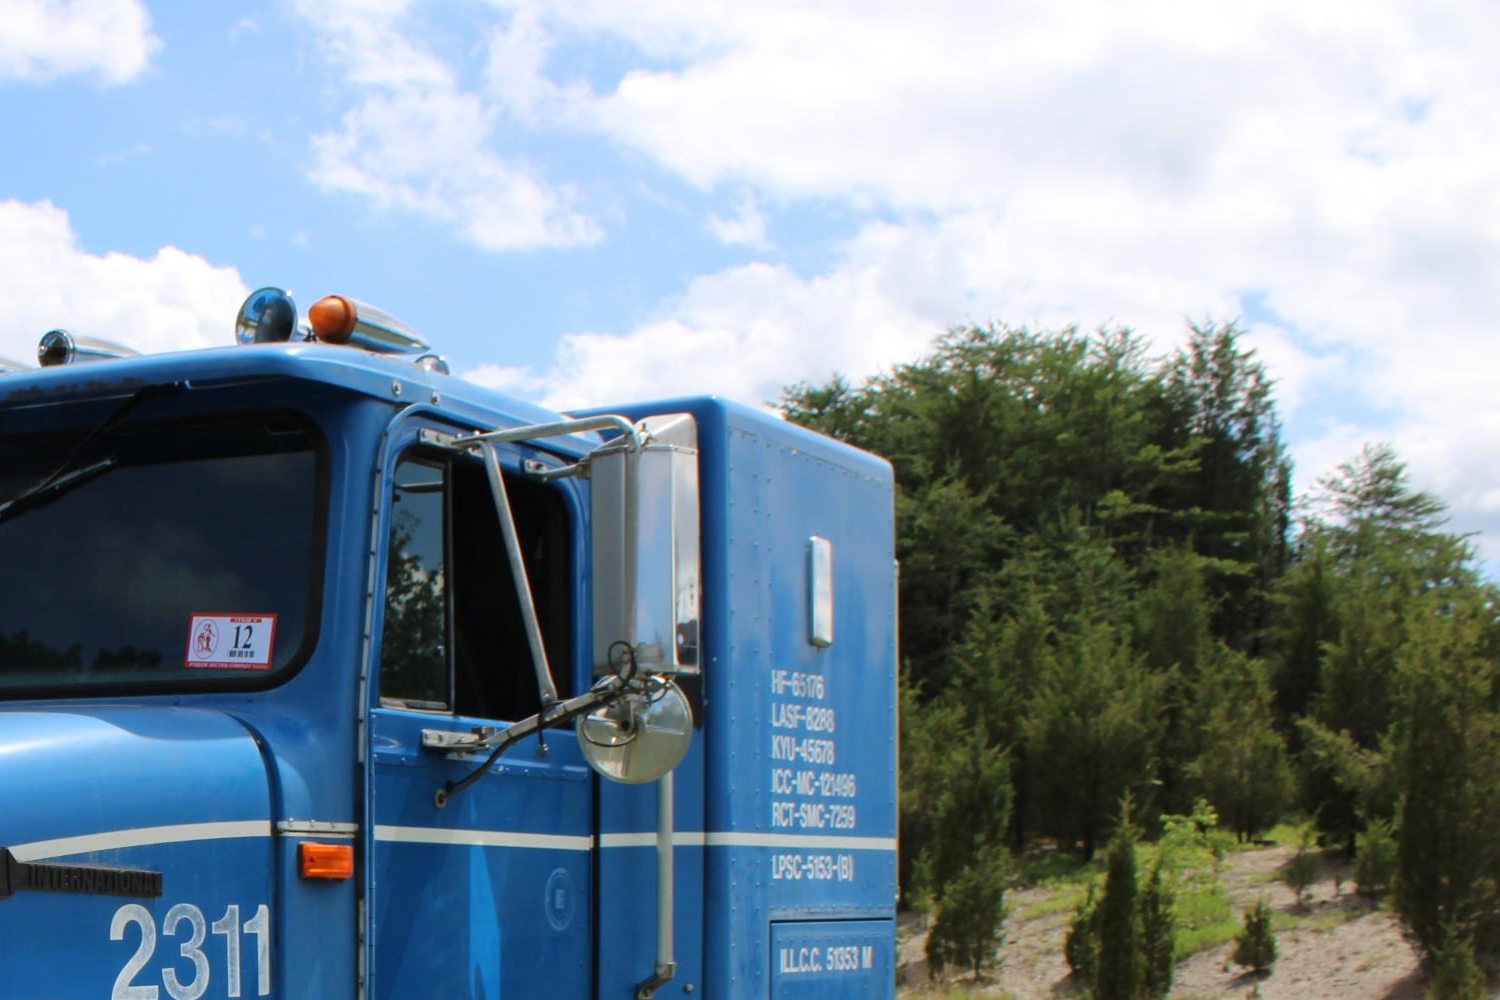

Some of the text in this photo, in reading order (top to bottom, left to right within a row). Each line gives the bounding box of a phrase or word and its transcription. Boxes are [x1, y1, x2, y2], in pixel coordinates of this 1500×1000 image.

[232, 625, 253, 649] 12
[771, 735, 835, 765] KYU-45678
[28, 864, 162, 897] INTERNATIONAL
